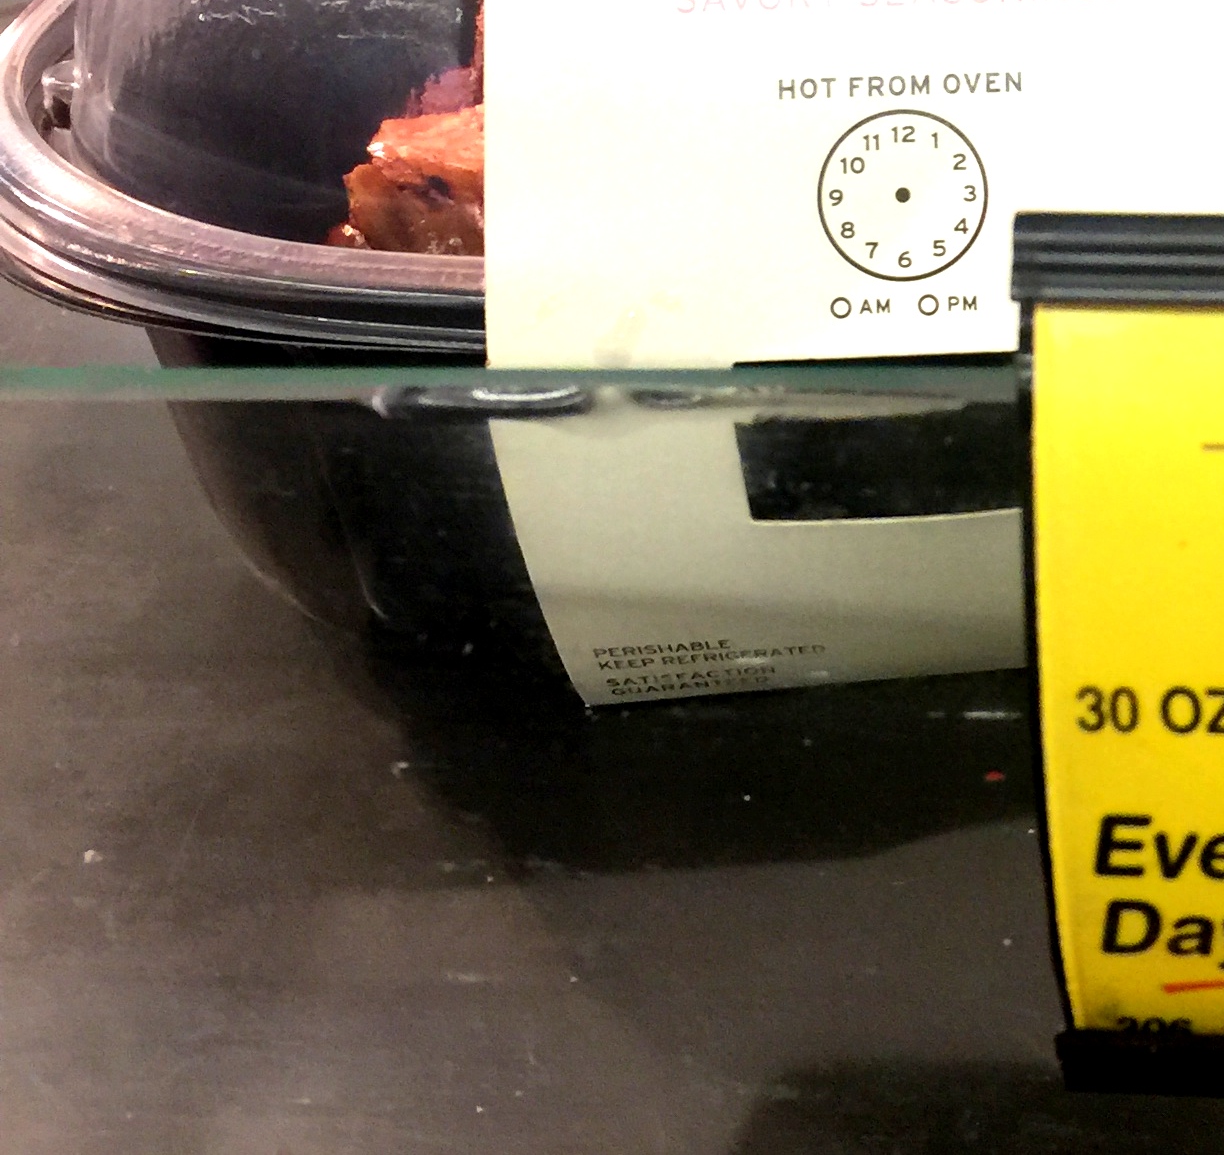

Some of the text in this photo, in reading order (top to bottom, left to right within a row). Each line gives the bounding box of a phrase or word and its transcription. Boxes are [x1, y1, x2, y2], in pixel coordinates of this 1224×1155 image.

[777, 71, 1023, 101] HOT FROM OVEN
[862, 133, 881, 151] 11
[891, 125, 917, 144] 12
[930, 132, 939, 149] 1
[839, 155, 866, 175] 10
[952, 152, 968, 171] 2
[828, 188, 844, 207] 9
[963, 184, 977, 202] 3
[840, 221, 856, 239] 8
[953, 217, 969, 235] 4
[865, 241, 879, 259] 7
[932, 239, 947, 257] 5
[898, 250, 912, 268] 6
[859, 295, 978, 315] AM PM
[592, 638, 732, 660] PERISHABLE
[598, 643, 827, 672] KEEP REFRIGERATED
[606, 665, 777, 688] SATISFACTION
[1074, 685, 1140, 735] 30
